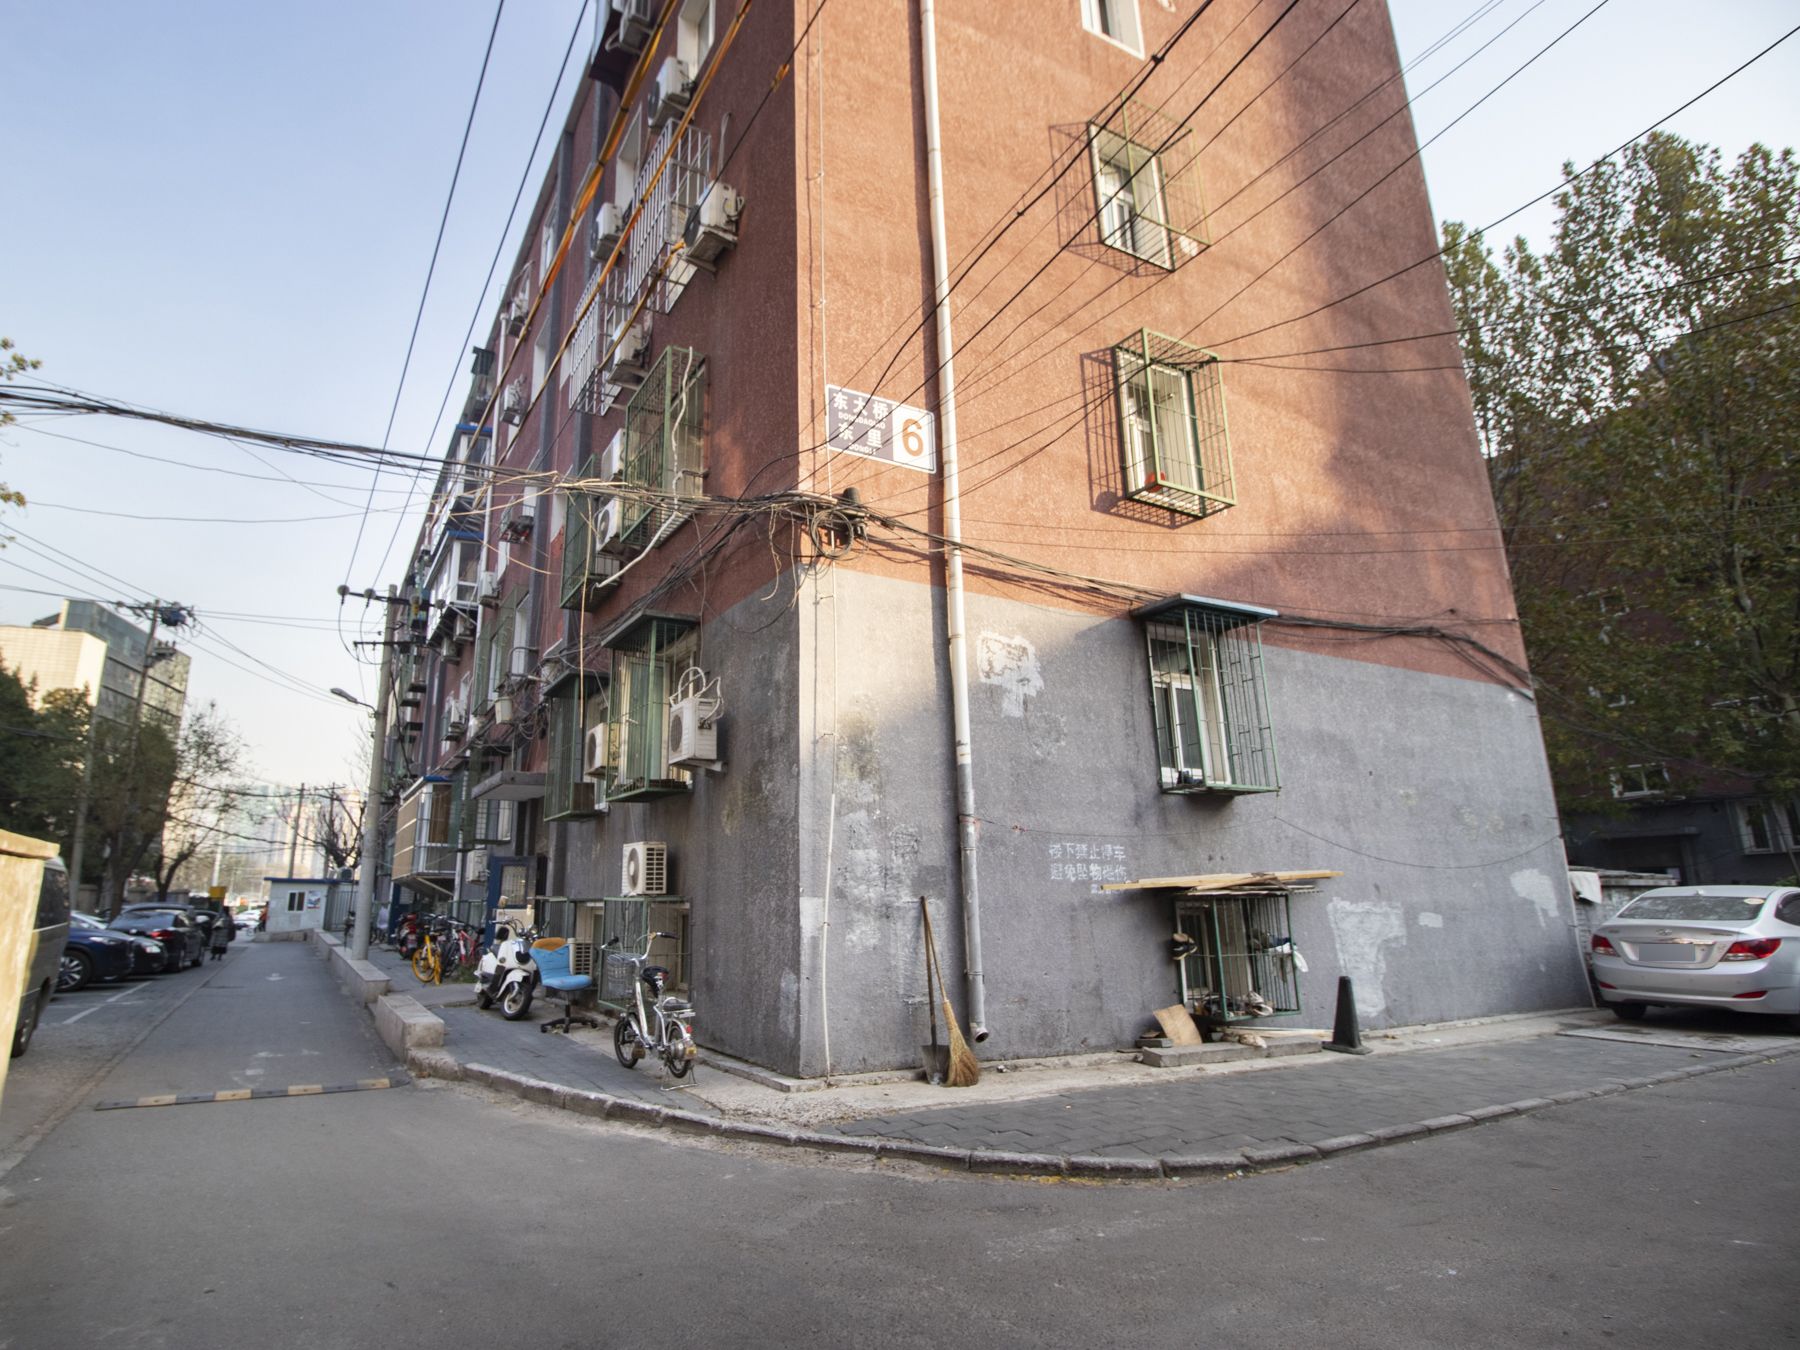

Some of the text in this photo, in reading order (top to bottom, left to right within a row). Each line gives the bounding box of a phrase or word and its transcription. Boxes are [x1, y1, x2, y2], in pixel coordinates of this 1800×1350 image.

[833, 392, 889, 420] 东大桥
[838, 422, 882, 448] 东里
[902, 418, 923, 457] 6
